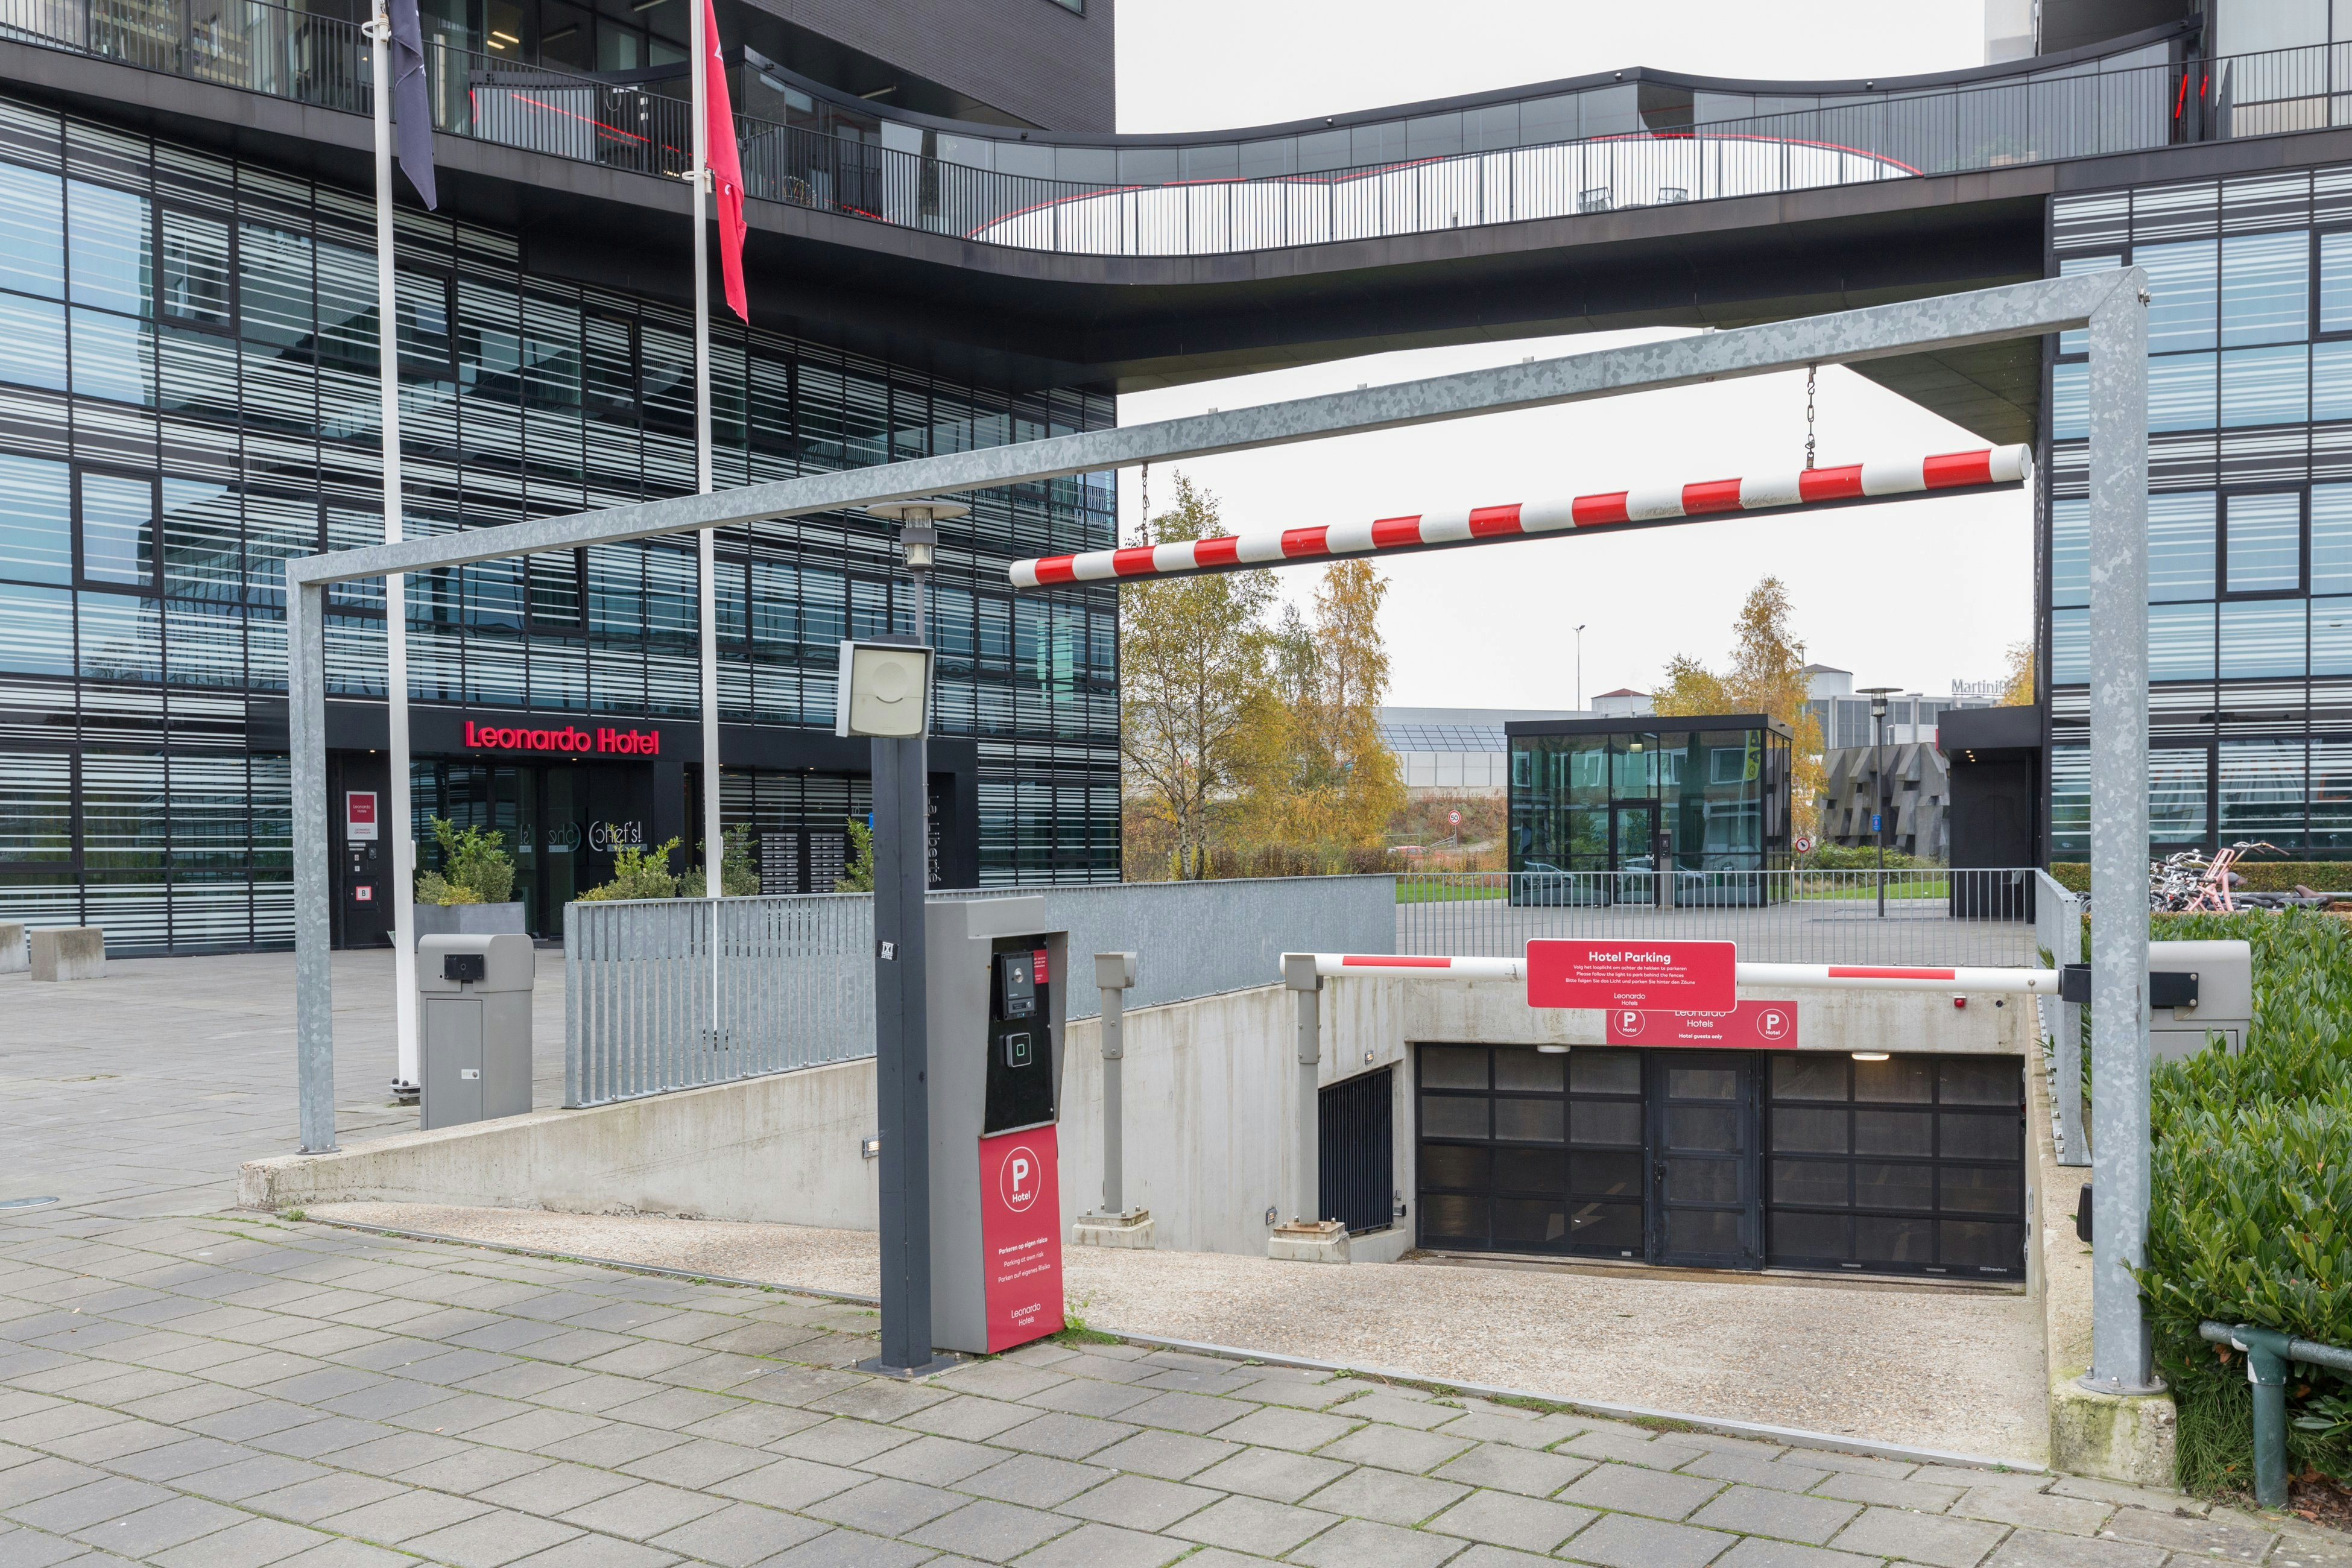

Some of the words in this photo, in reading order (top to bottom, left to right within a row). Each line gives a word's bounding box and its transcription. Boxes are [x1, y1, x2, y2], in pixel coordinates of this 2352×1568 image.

[465, 721, 591, 751] Leonardo
[596, 728, 659, 754] Hotel
[929, 795, 939, 814] La
[929, 823, 941, 882] Liberté
[1589, 952, 1621, 961] Hotel
[1625, 952, 1671, 964] Parking
[1623, 1012, 1636, 1027] P
[1687, 1019, 1713, 1028] Hotels
[1767, 1014, 1779, 1029] P
[1013, 1158, 1029, 1192] P
[1013, 1190, 1030, 1203] Hotel
[999, 1245, 1018, 1255] Parkeren
[1004, 1259, 1020, 1267] Parking
[998, 1274, 1014, 1283] Parken
[1022, 1267, 1038, 1277] eigenes
[1011, 1303, 1041, 1319] Leonardo
[1019, 1316, 1034, 1326] Hotels
